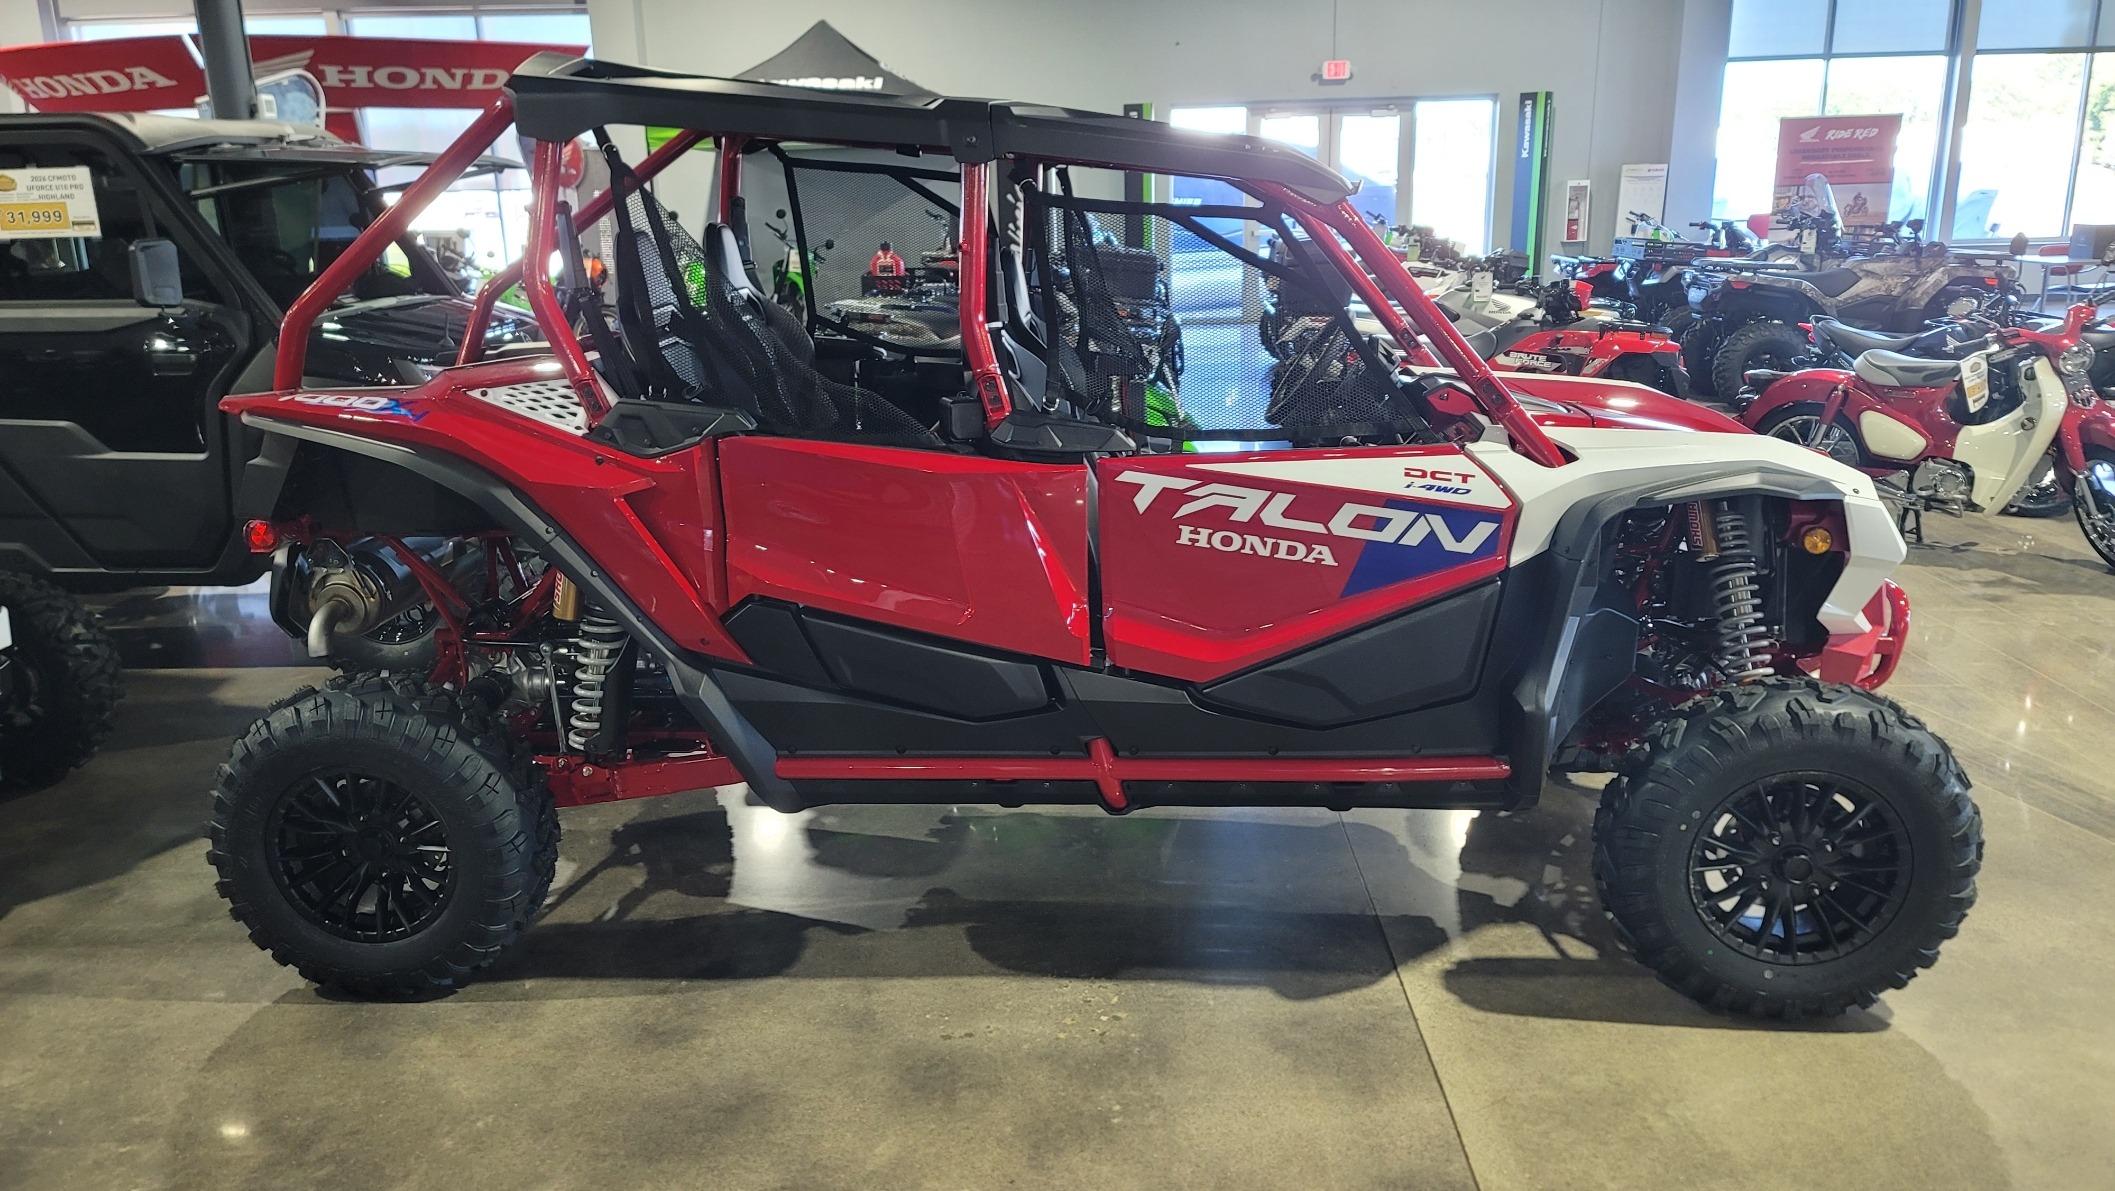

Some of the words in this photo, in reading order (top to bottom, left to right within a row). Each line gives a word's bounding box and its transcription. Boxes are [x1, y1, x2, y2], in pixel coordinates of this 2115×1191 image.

[14, 66, 178, 99] HONDA
[318, 64, 511, 91] HOND
[1521, 99, 1533, 158] Kawasaki
[1825, 129, 1853, 140] RIDE
[1853, 128, 1879, 140] RED
[48, 174, 77, 182] CFMOTO
[1510, 351, 1547, 361] BRUTE
[1515, 358, 1552, 368] FORCE
[1404, 467, 1476, 484] DCT
[1404, 482, 1472, 495] i-4WD
[1114, 470, 1501, 555] TALON
[1688, 502, 1703, 547] SHOWA
[1176, 525, 1339, 567] HONDA
[554, 570, 564, 605] SHO
